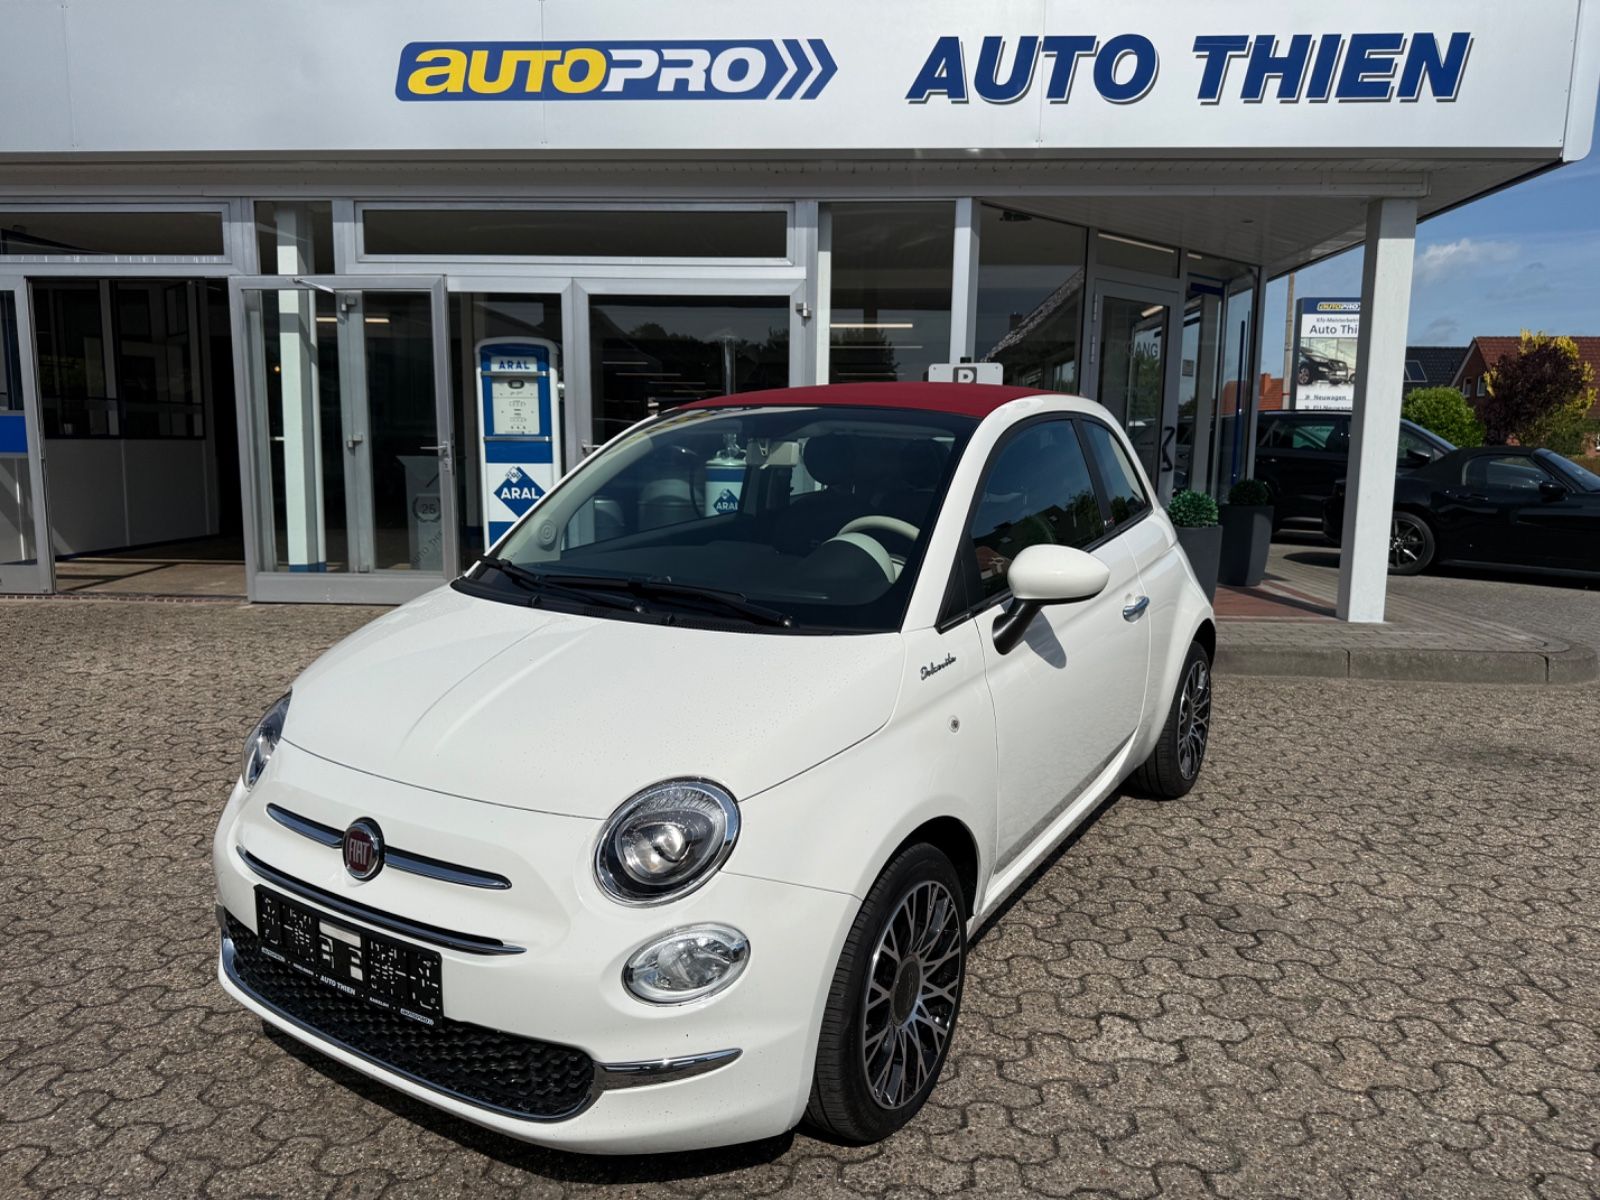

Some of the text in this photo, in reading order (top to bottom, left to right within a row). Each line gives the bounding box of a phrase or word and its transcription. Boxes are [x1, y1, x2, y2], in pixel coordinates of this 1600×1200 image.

[905, 31, 1475, 105] AUTO THIEN
[1309, 324, 1337, 335] Auto
[499, 360, 530, 370] ARAL
[500, 487, 541, 500] ARAL
[348, 837, 370, 865] FIAT
[320, 975, 356, 996] AUTO THIEN
